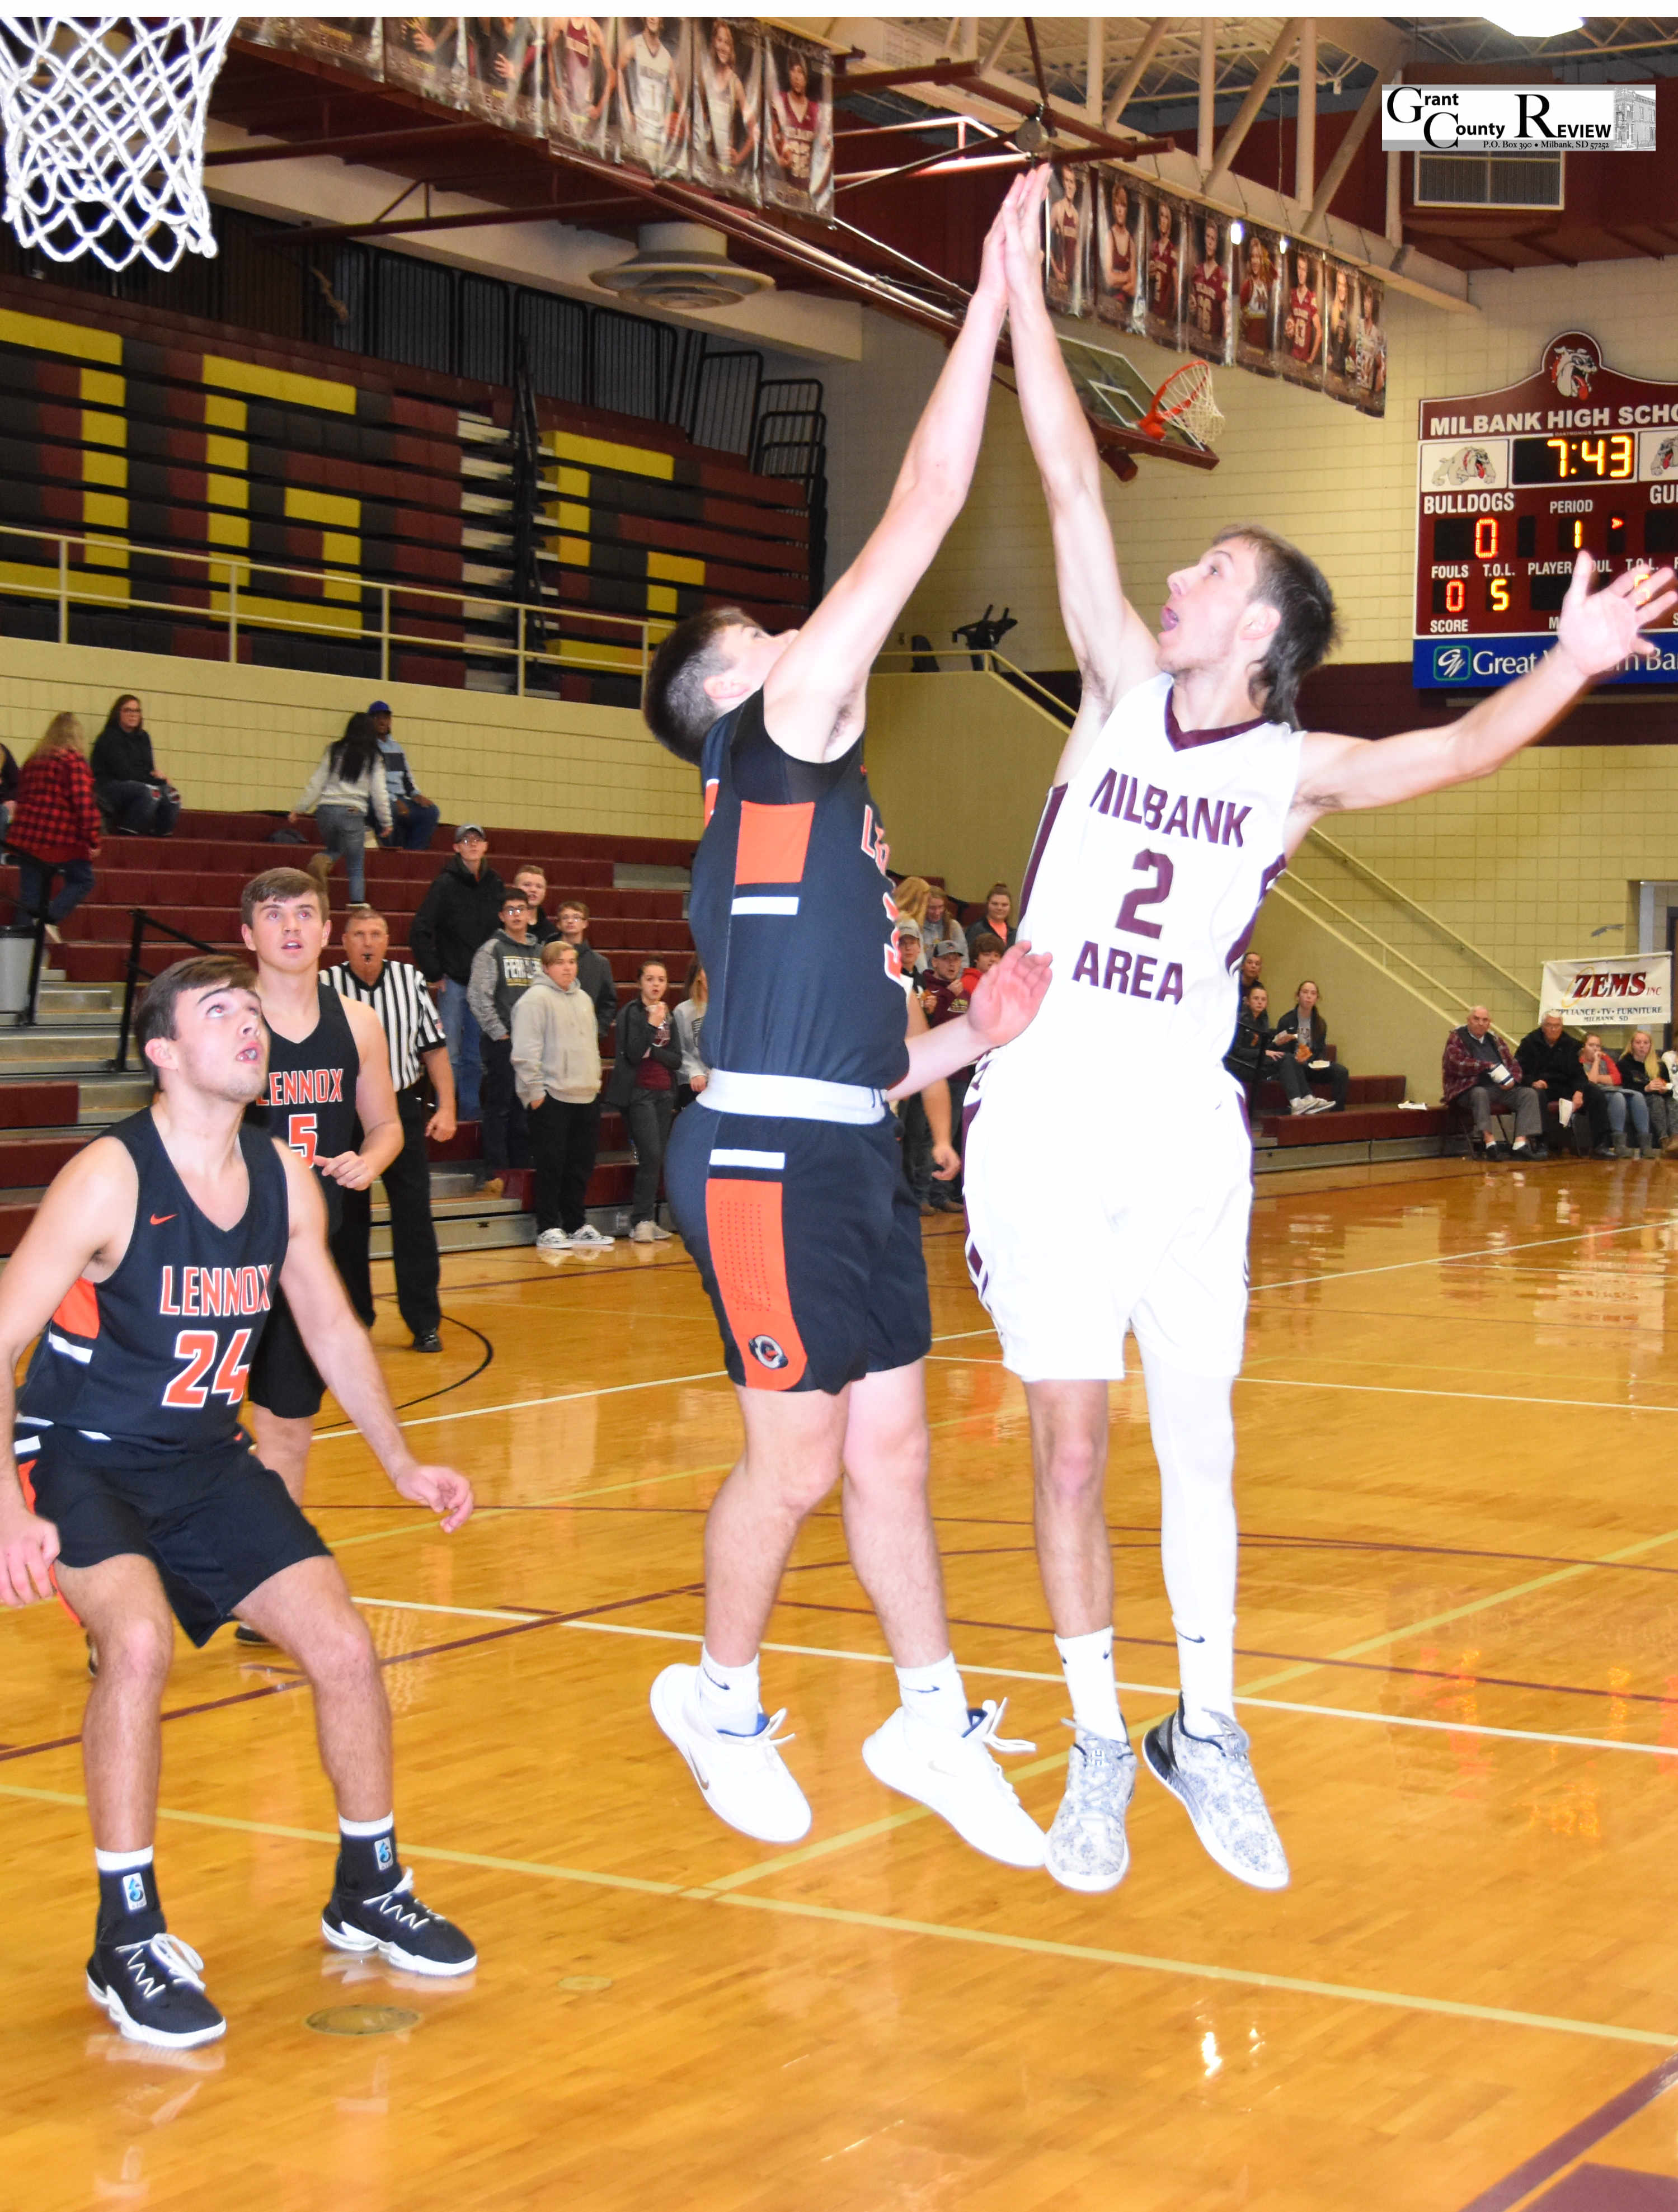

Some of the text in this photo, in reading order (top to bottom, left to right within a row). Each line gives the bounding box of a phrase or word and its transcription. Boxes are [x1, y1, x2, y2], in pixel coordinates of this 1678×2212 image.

[1430, 411, 1541, 436] MILBANK
[1547, 408, 1609, 430] HIGH
[1547, 435, 1632, 478] 7:43
[1423, 492, 1515, 514] BULLDOGS
[1549, 500, 1594, 514] PERIOD
[1474, 517, 1498, 559] 0
[1574, 520, 1582, 549] 1
[1431, 564, 1469, 578] FOULS
[1483, 563, 1515, 577] T.O.L.
[1527, 559, 1613, 575] PLAYER OUL
[1445, 580, 1465, 613] 0
[1430, 619, 1469, 633] SCORE
[1472, 650, 1537, 675] Great
[1115, 848, 1174, 940] 2
[1071, 940, 1183, 1005] AREA
[1572, 972, 1661, 999] ZEMS INC
[1616, 1006, 1662, 1015] FURNITURE
[289, 1113, 318, 1169] 5
[159, 1264, 272, 1317] LENNOX
[161, 1328, 252, 1409] 24
